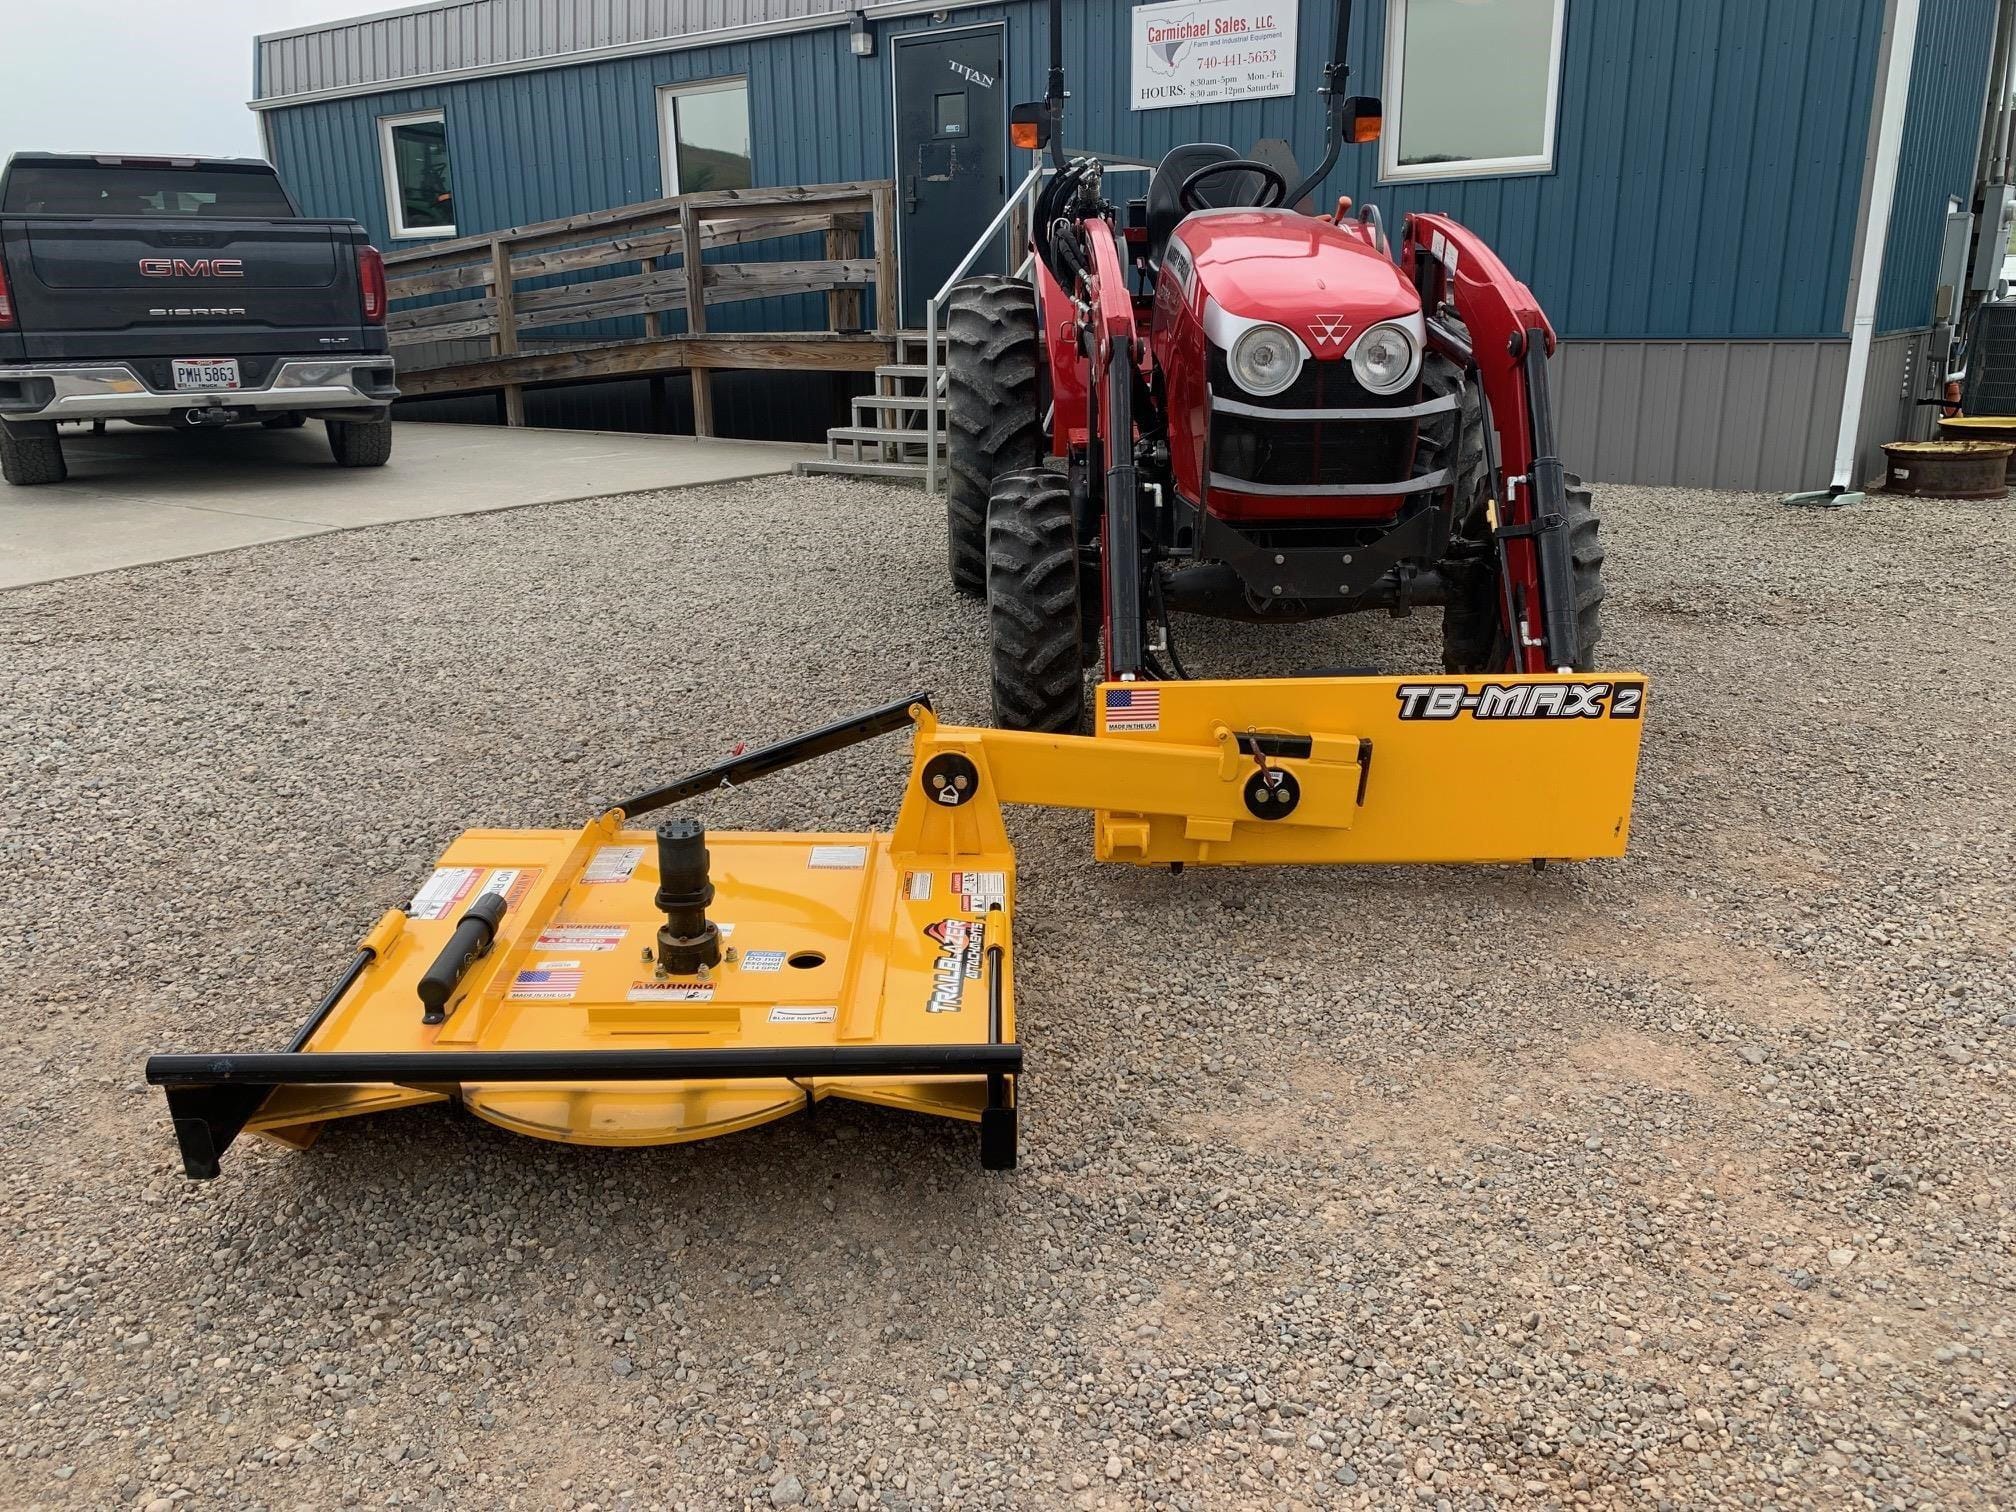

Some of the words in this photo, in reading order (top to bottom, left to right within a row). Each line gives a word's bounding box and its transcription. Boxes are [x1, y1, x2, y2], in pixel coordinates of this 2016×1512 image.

[1148, 19, 1210, 43] Carmichael
[1215, 16, 1251, 35] Sales,
[1255, 15, 1276, 30] LLC.
[1193, 40, 1209, 48] Farm
[1209, 38, 1221, 46] and
[1222, 36, 1249, 46] Industrial
[1250, 31, 1282, 42] Equipment
[1197, 50, 1277, 70] 740-441-5653
[948, 59, 995, 86] TITAN
[1141, 84, 1186, 100] HOURS:
[1246, 83, 1281, 93] Saturday
[139, 258, 244, 277] GMC
[149, 308, 246, 316] SIERRA
[177, 367, 202, 382] PMH
[204, 367, 235, 382] 5863
[1398, 684, 1610, 719] TB-MAX
[1612, 688, 1642, 715] 2
[927, 919, 966, 1013] TRAILBLAZER
